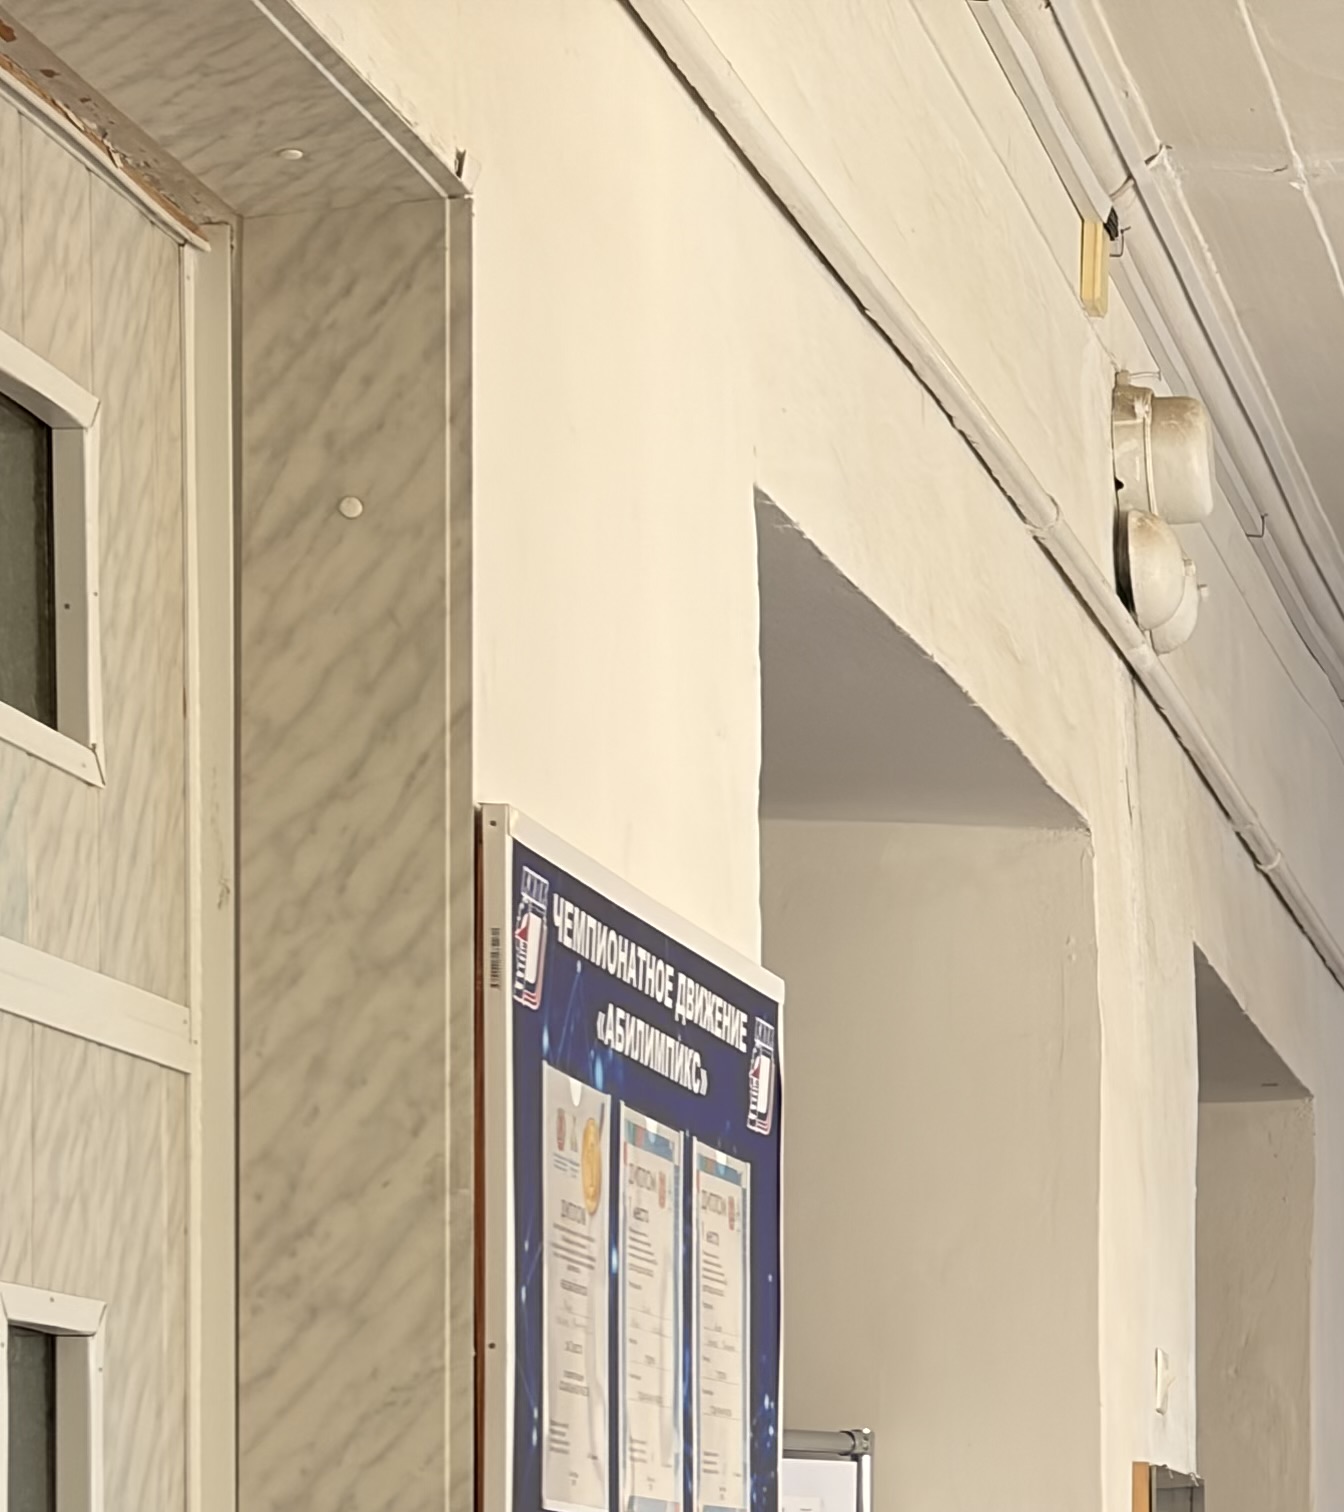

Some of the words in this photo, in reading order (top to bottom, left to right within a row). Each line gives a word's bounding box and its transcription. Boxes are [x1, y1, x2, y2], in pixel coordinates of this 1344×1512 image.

[553, 893, 675, 1009] ЧЕМПИОНАТНОЕ
[674, 971, 749, 1053] ДВИЖЕНИЕ
[596, 1002, 708, 1096] «АБИЛИМПИКС»
